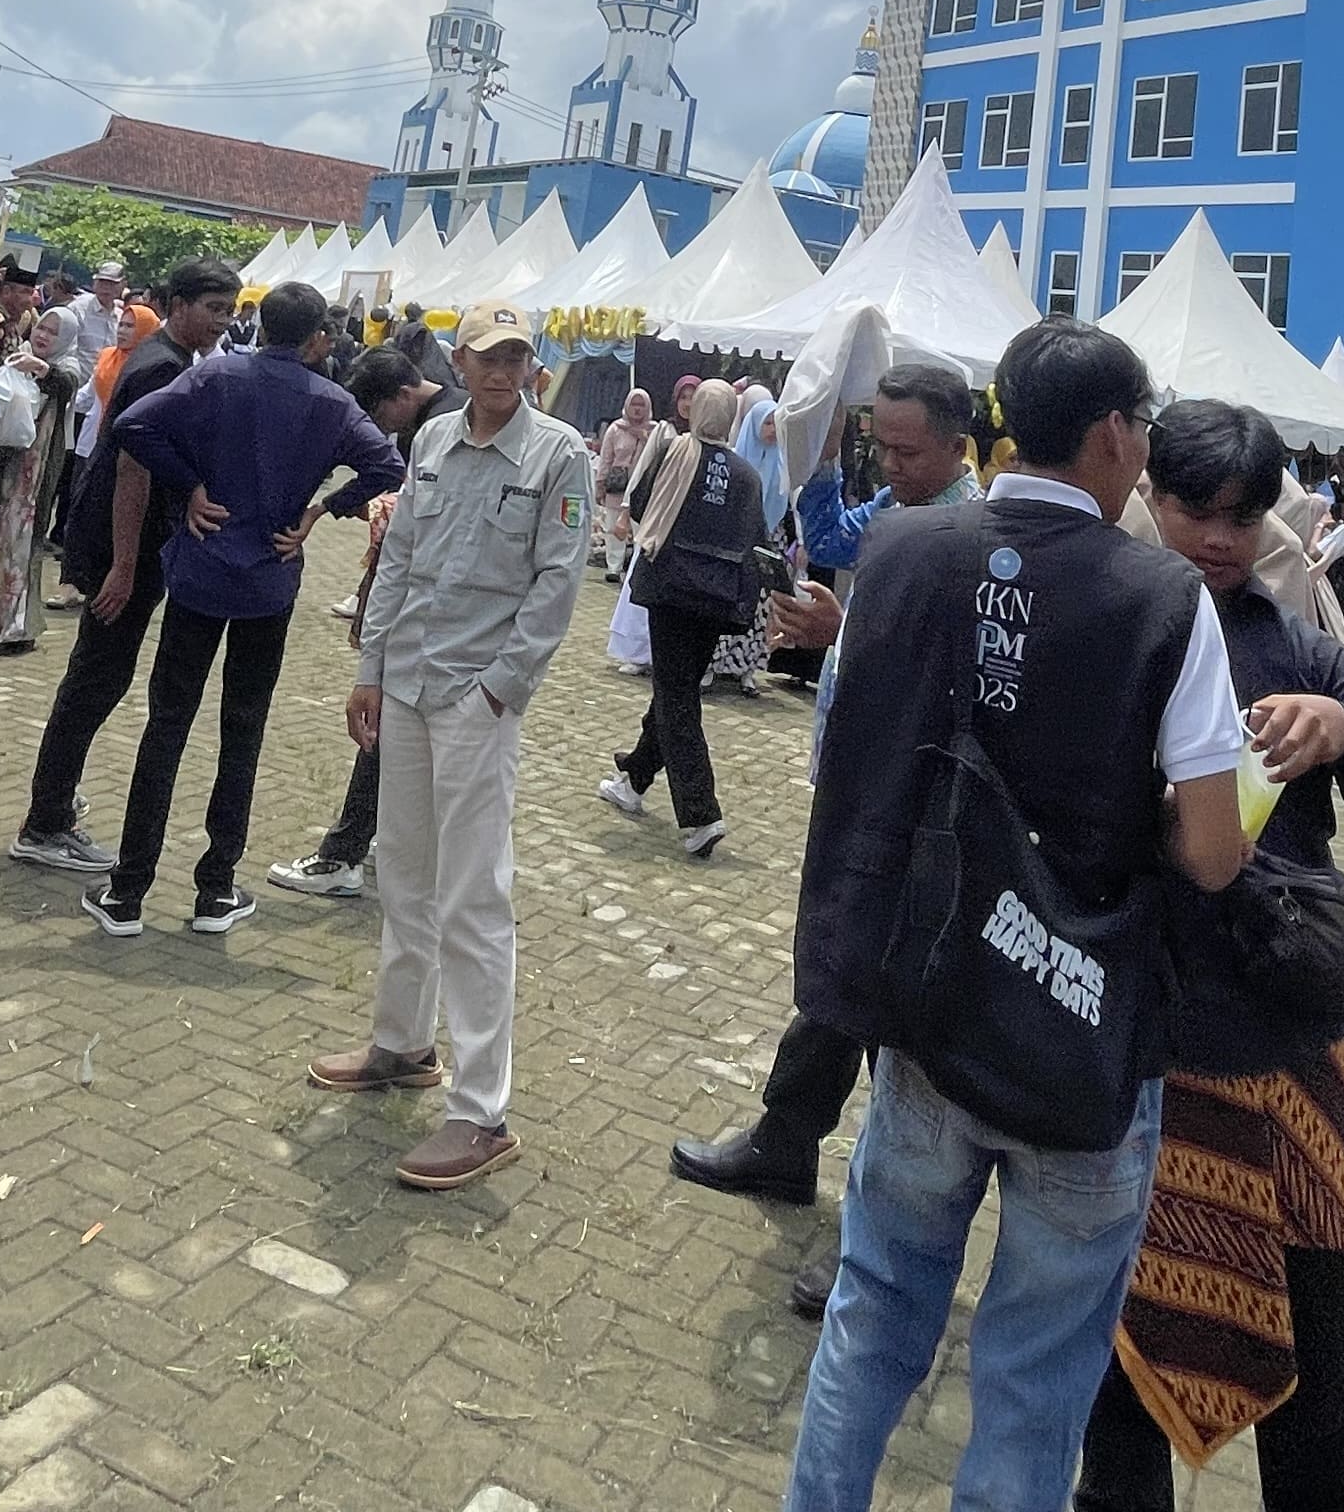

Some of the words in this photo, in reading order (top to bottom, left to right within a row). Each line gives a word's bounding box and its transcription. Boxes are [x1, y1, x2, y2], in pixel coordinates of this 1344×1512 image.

[981, 913, 1051, 985] HAPPY
[1050, 970, 1101, 1026] DAYS
[996, 890, 1048, 954] GOOD
[1049, 935, 1105, 998] TIMES
